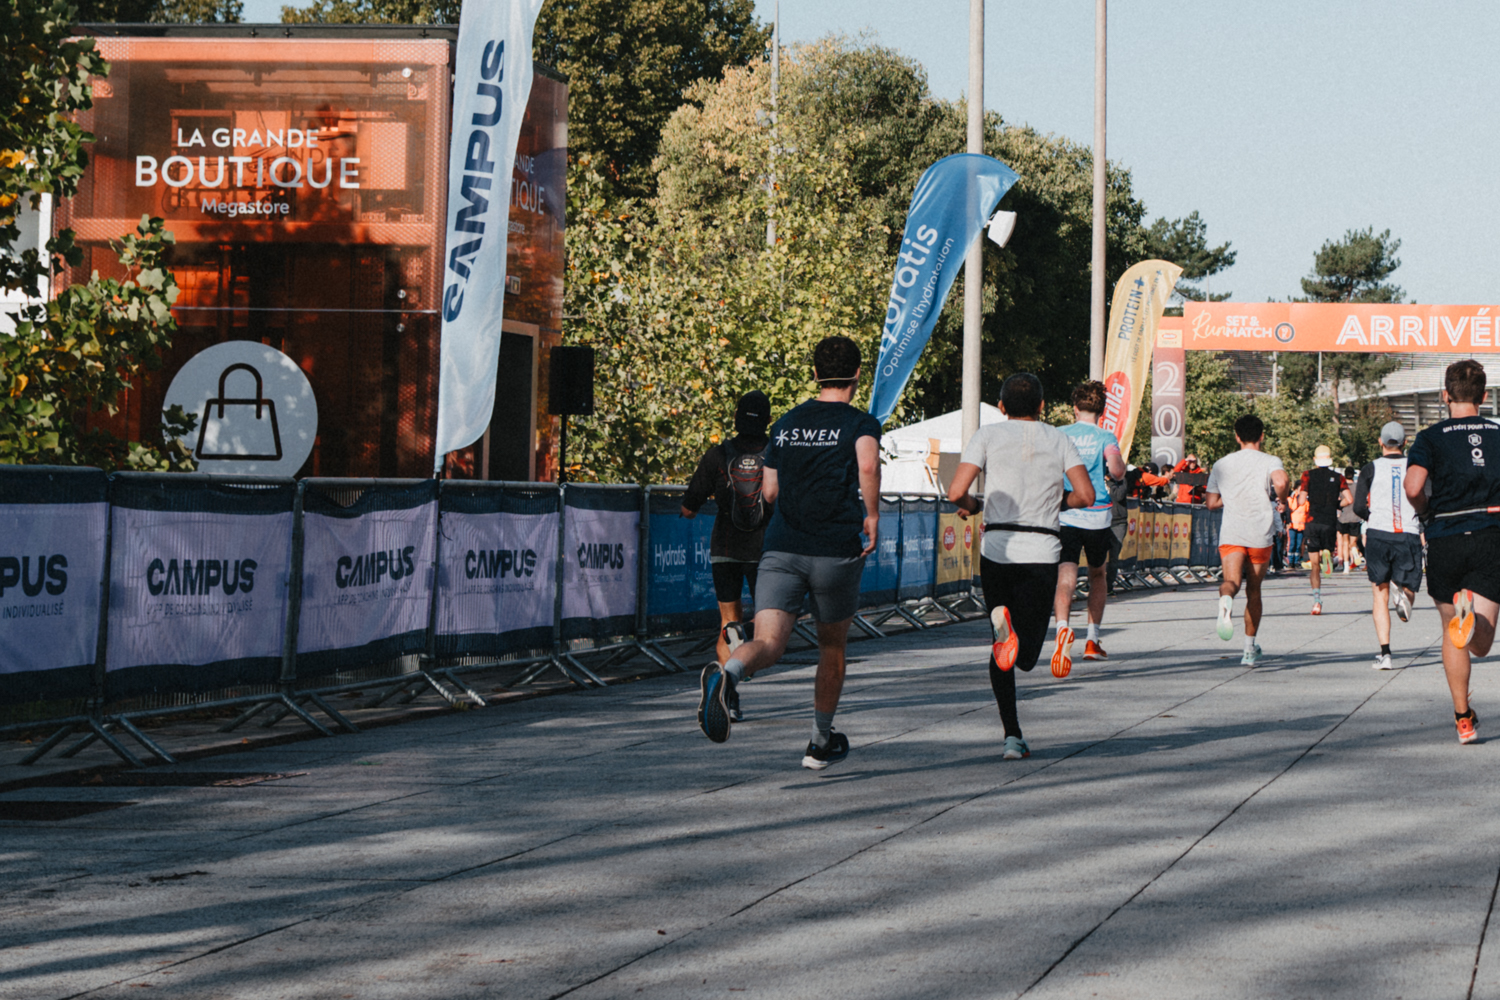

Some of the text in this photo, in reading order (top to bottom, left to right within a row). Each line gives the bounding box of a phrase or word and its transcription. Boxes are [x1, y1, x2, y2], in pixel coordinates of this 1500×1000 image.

[177, 127, 319, 149] LA GRANDE
[135, 154, 361, 189] BOUTIQUE
[513, 154, 535, 175] ANDE
[200, 197, 290, 218] Megastore
[1192, 309, 1227, 341] Run
[1225, 315, 1260, 327] SET &
[1225, 327, 1273, 339] MATCH
[1101, 381, 1125, 435] arilla
[790, 428, 841, 441] SWEN
[335, 545, 415, 588] CAMPUS
[465, 549, 538, 580] CAMPUS
[577, 542, 624, 570] CAMPUS
[0, 553, 68, 598] PUS
[146, 558, 258, 596] CAMPUS
